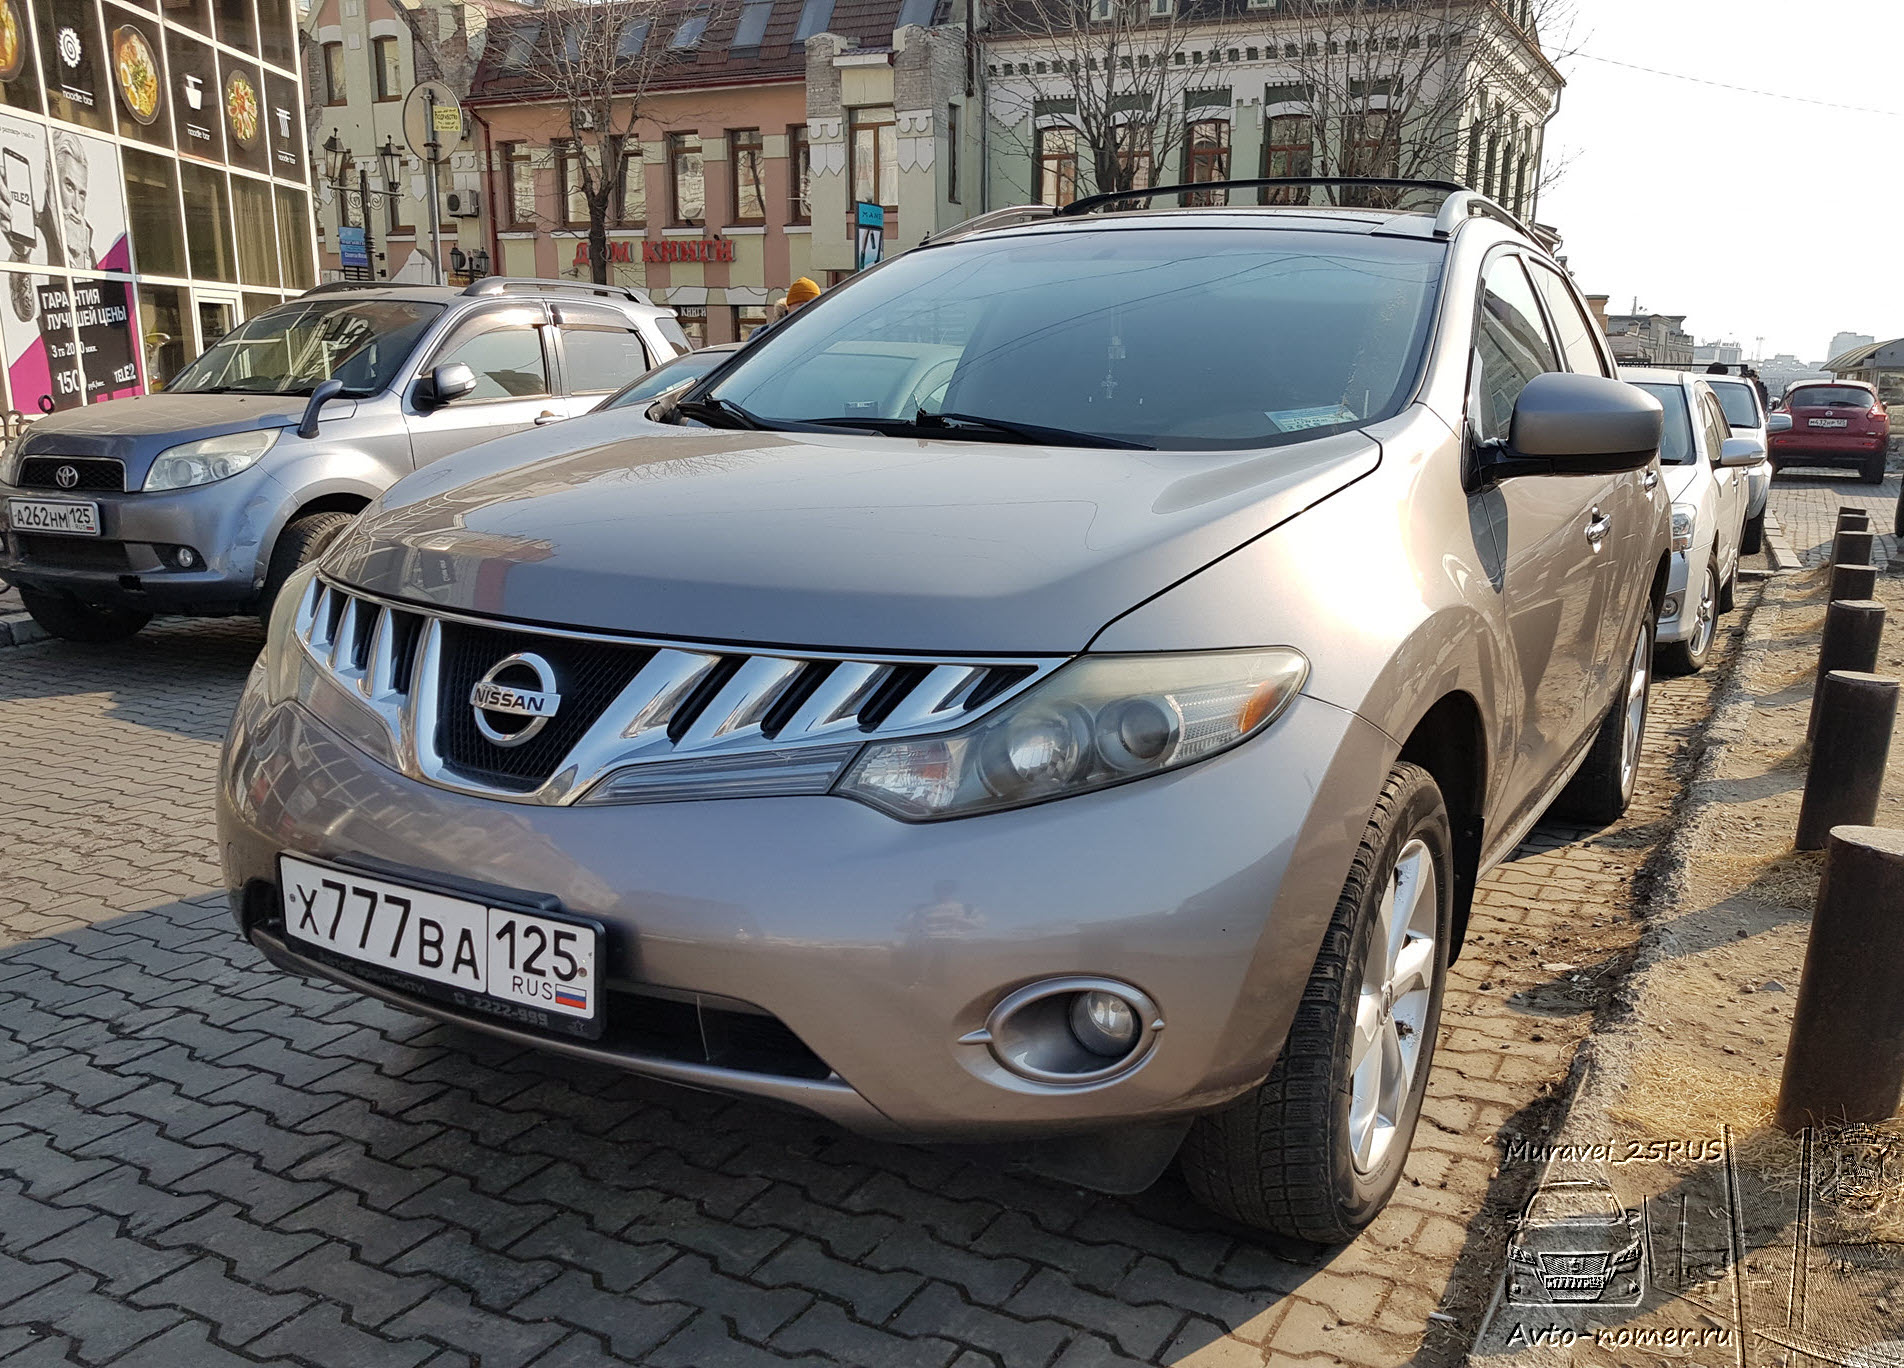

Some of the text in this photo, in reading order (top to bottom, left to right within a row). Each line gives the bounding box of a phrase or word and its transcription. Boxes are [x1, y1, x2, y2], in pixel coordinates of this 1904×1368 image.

[62, 90, 93, 106] noodle bar
[573, 239, 735, 267] ДМ КНИГИ
[41, 288, 101, 310] ГАРАНТИЯ
[47, 305, 127, 331] ЛУЧШЕЙ ЦЕНЫ
[51, 344, 58, 358] 3
[113, 363, 136, 383] TELE2
[17, 506, 91, 528] А262НМ 125
[474, 687, 545, 712] NISSAN
[296, 878, 481, 981] Х777ВА
[495, 920, 578, 982] 125
[511, 976, 553, 1001] RUS
